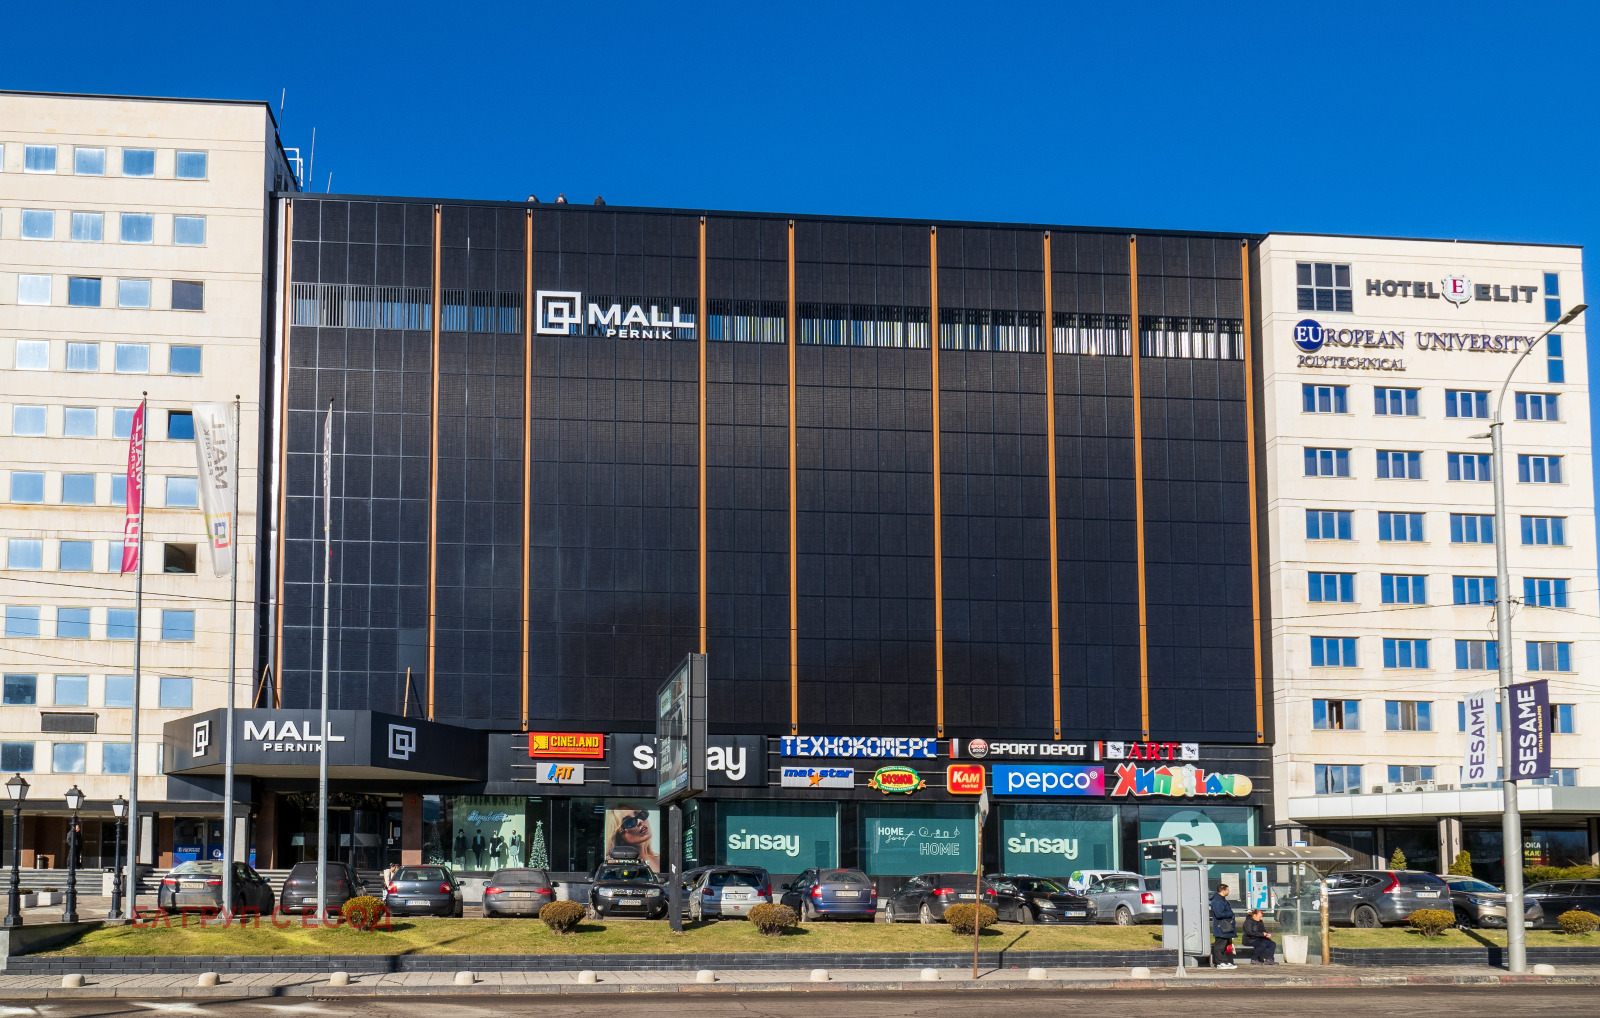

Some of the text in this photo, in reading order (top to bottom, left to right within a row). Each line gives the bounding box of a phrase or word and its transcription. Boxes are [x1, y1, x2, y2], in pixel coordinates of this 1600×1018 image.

[1366, 279, 1440, 298] HOTEL
[1474, 284, 1538, 303] ELIT
[588, 303, 695, 328] MALL
[606, 329, 672, 340] PERNIK
[1295, 326, 1535, 354] EUROPEAN UNIVERSITY
[1297, 355, 1406, 371] POLYTECHNICAL
[243, 721, 345, 741] MALL
[263, 742, 322, 752] PERNIK
[550, 735, 600, 748] CINELAND
[781, 735, 937, 758] ТЕХНОКОМЕРС
[990, 743, 1087, 756] SPORT DEPOT
[1128, 742, 1179, 761] ART
[783, 768, 853, 778] mat star
[881, 773, 913, 784] БОЗМОВ
[952, 771, 980, 783] KAM
[1008, 771, 1091, 793] pepco
[878, 827, 904, 836] HOME
[728, 828, 800, 857] sinsay
[919, 842, 960, 856] HOME
[1007, 832, 1078, 860] sinsay
